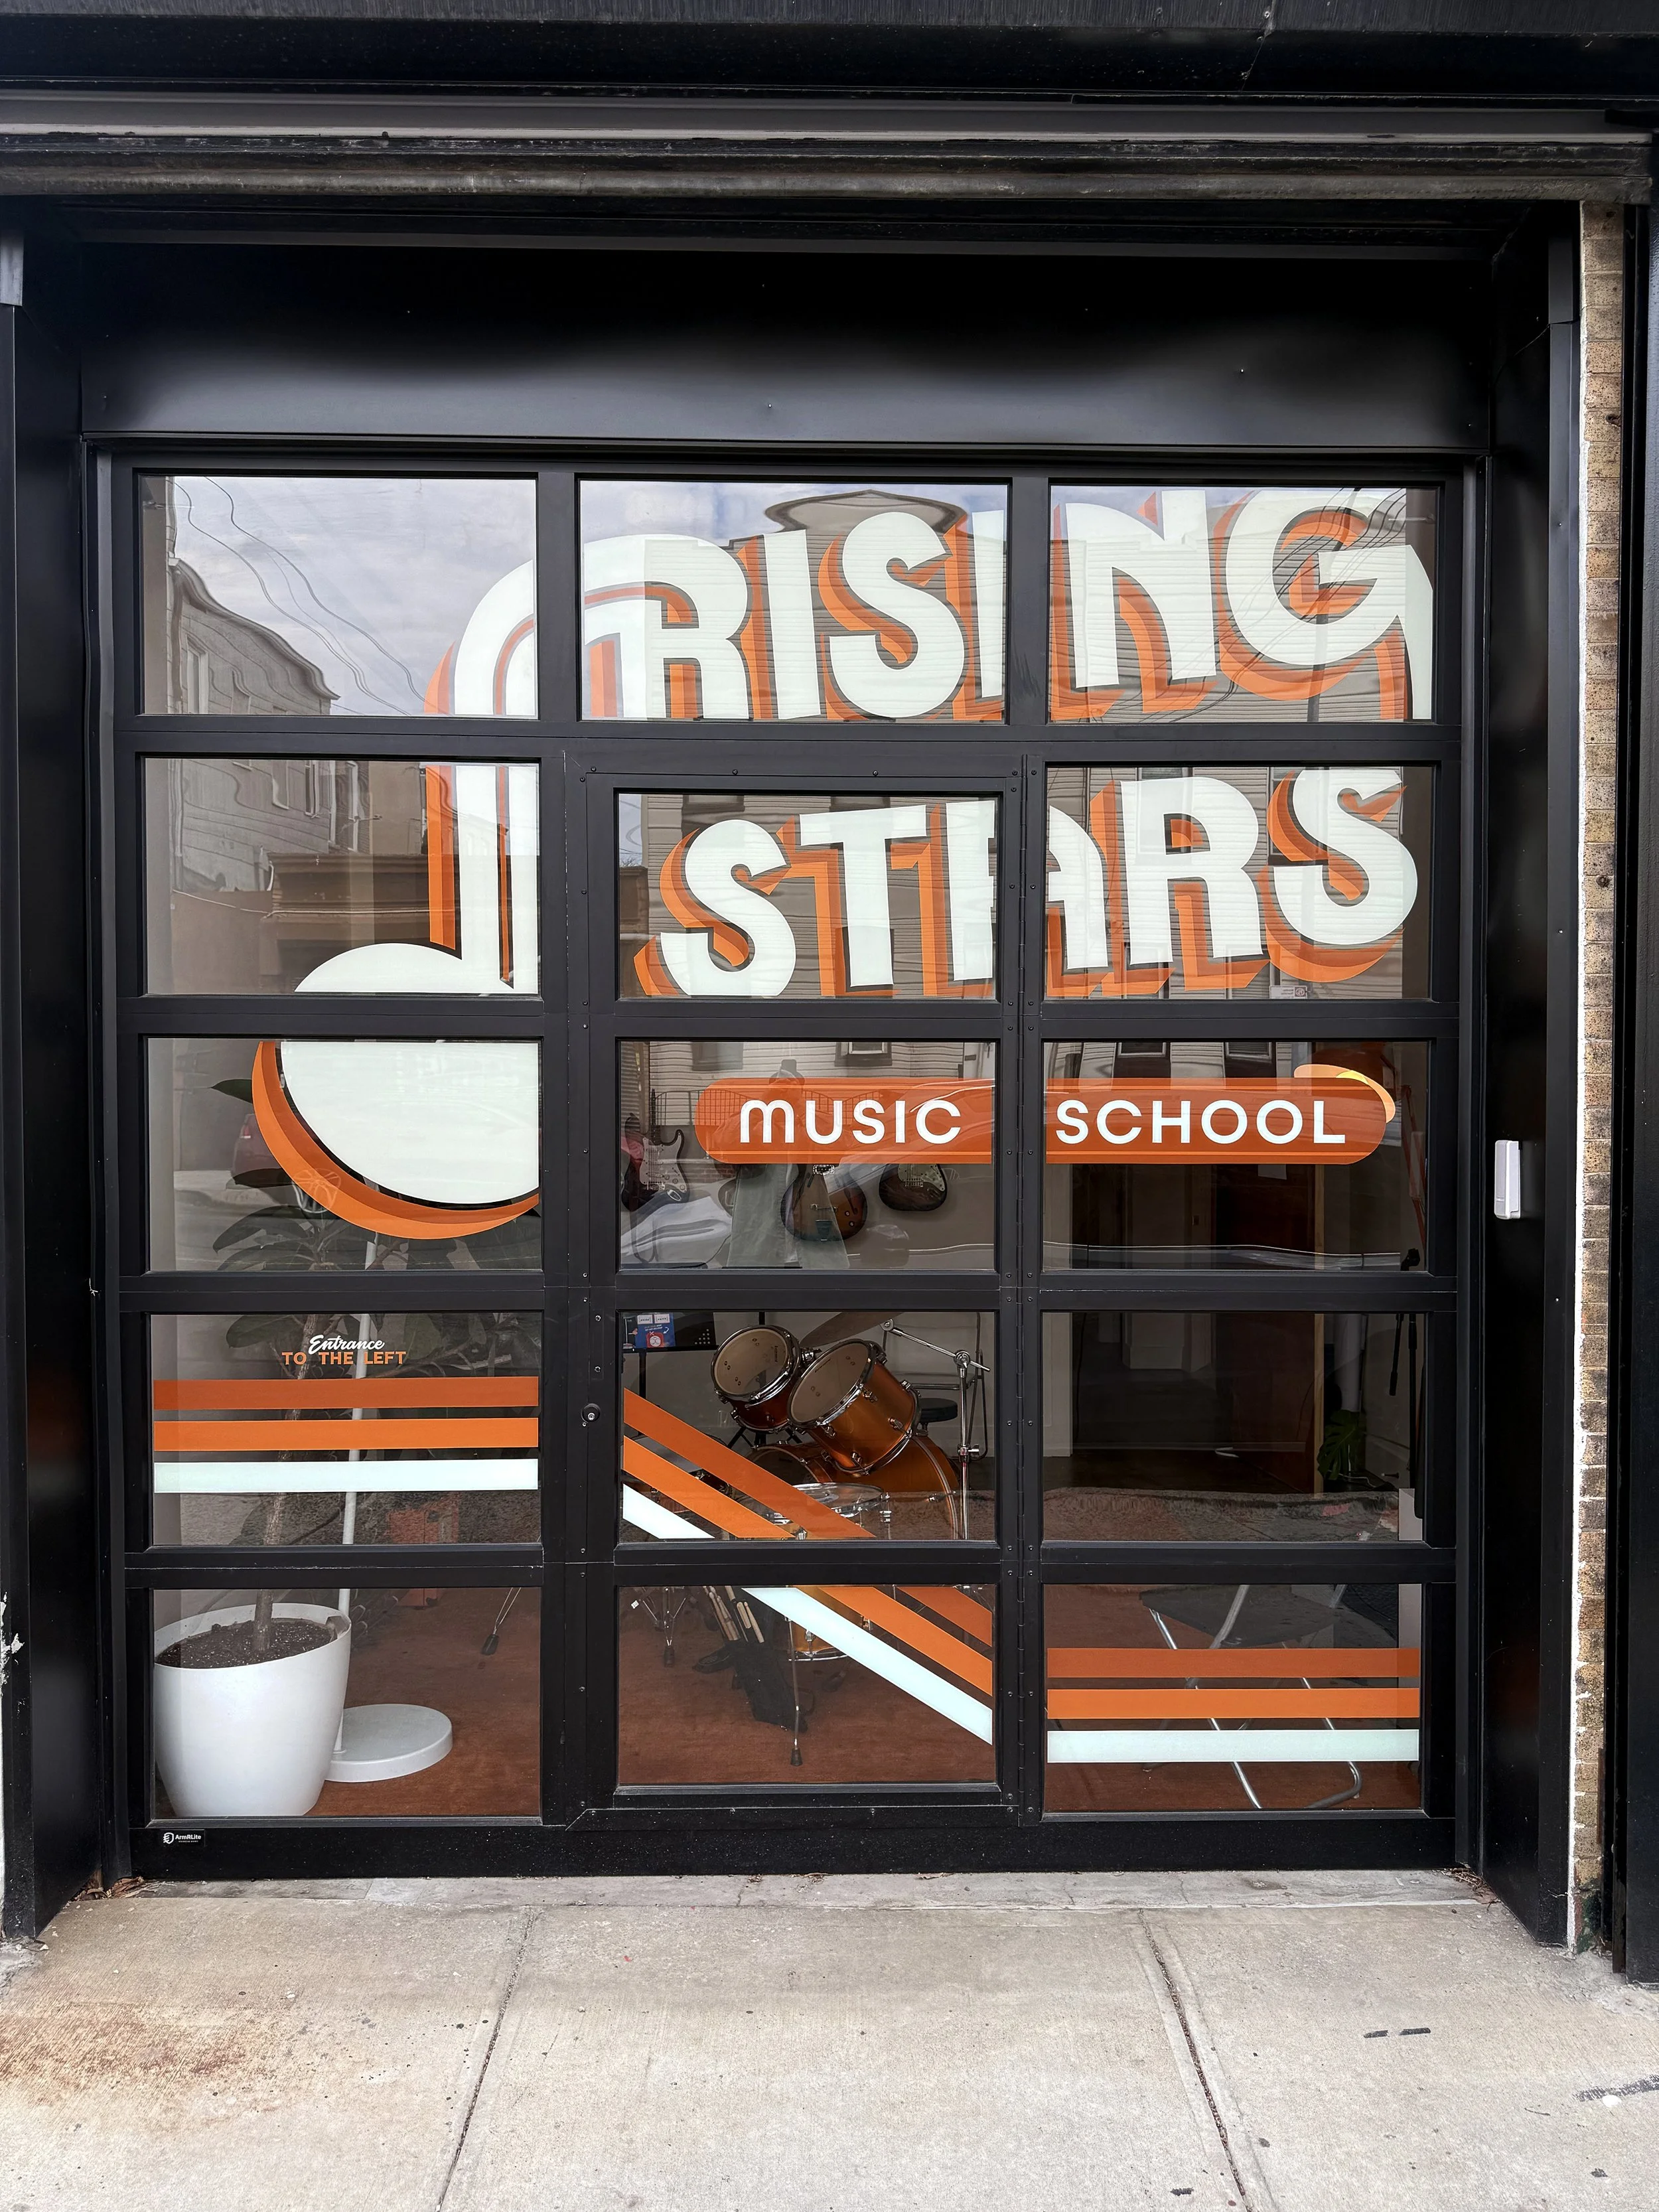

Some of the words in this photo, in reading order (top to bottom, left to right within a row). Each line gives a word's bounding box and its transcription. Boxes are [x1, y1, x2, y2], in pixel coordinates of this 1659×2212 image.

[584, 490, 1433, 720] RISING
[660, 769, 1418, 996] STARS
[740, 1099, 961, 1144] MUSIC
[1056, 1099, 1346, 1144] SCHOOL
[281, 1352, 307, 1365] TO
[319, 1352, 354, 1365] THE
[364, 1351, 406, 1364] LEFT
[309, 1335, 385, 1355] Entrance
